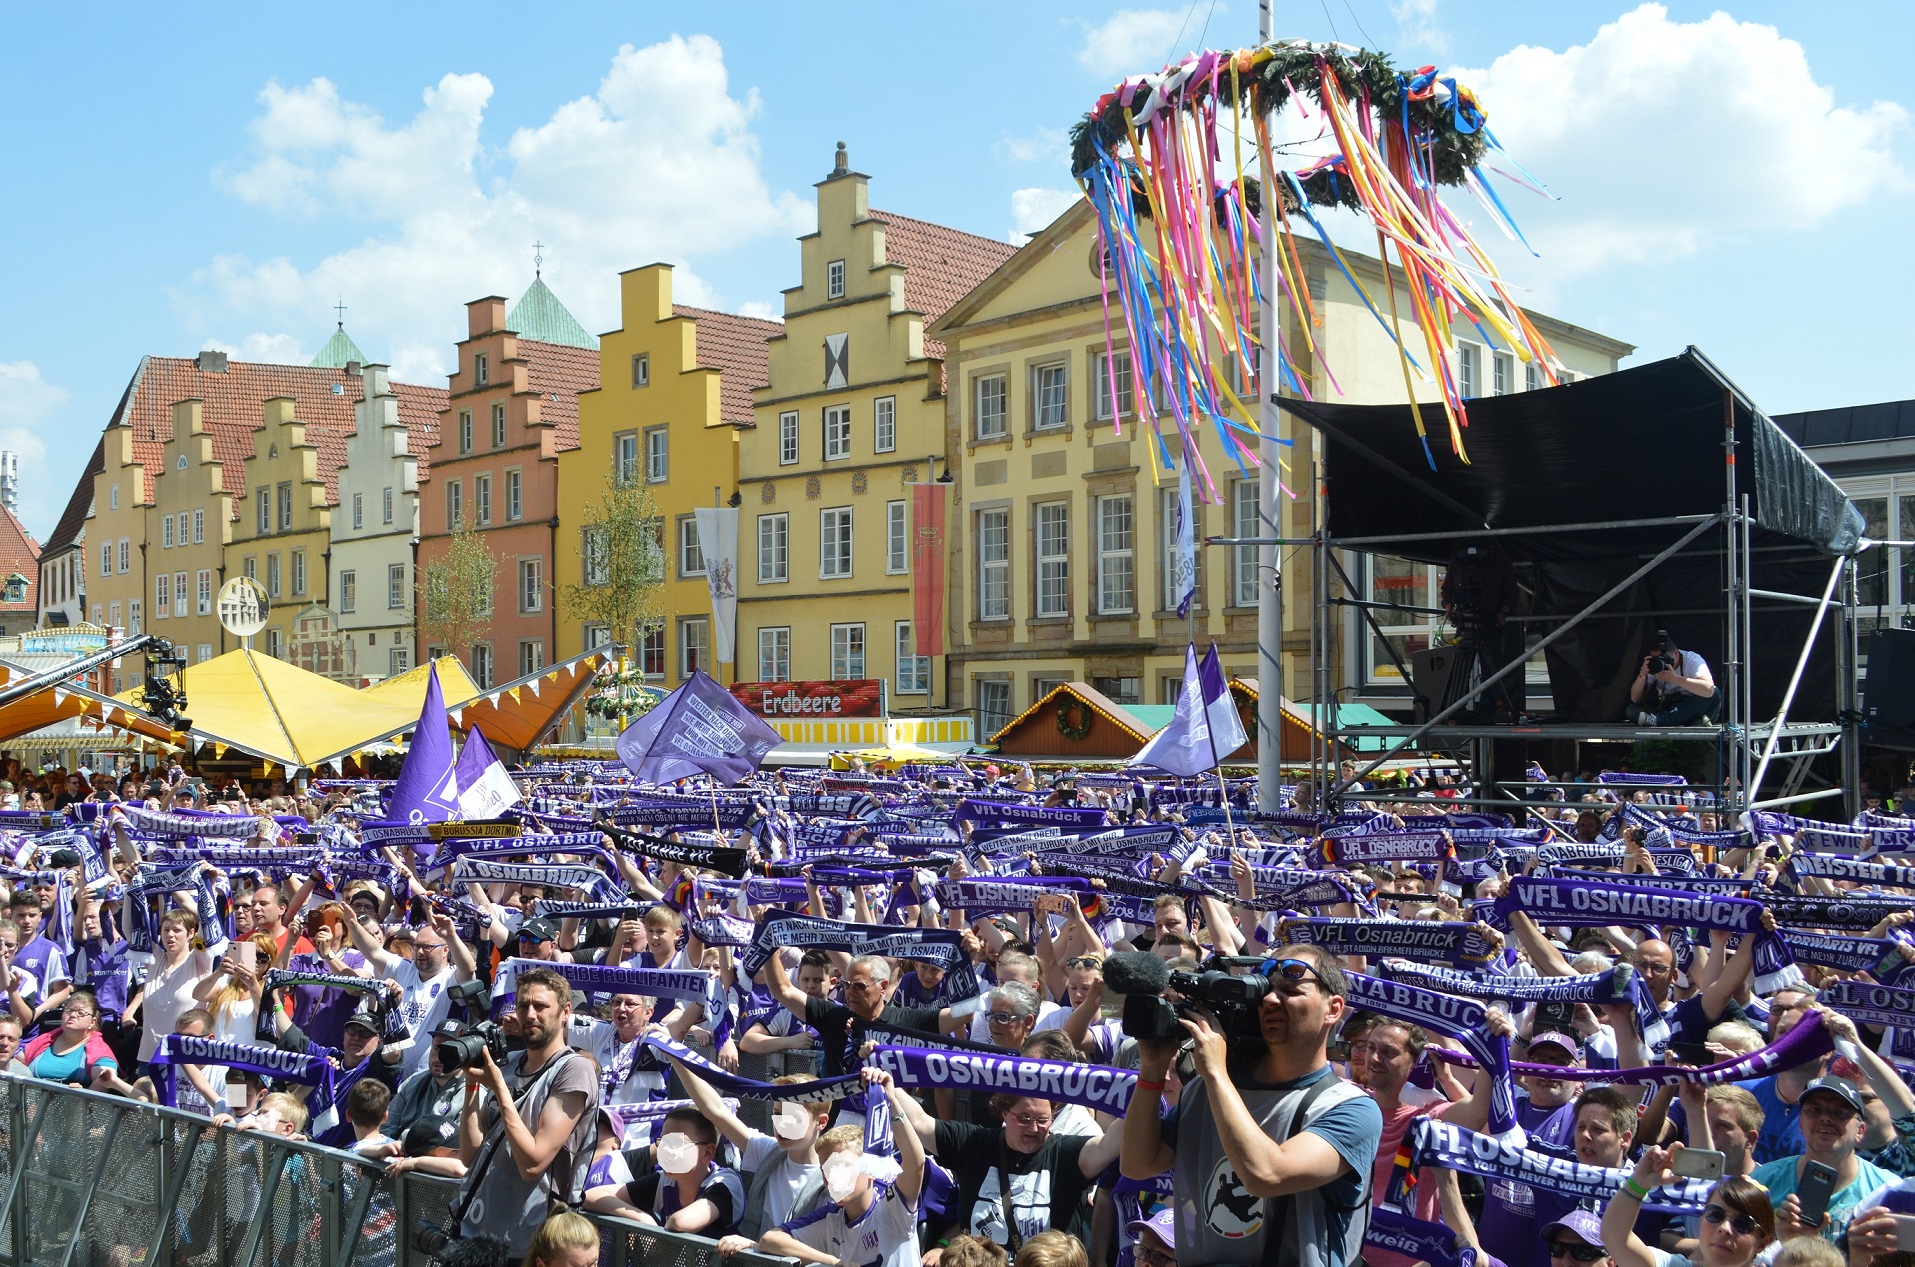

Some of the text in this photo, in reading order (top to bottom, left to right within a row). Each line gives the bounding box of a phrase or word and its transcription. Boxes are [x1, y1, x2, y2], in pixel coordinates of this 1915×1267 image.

[762, 690, 842, 714] Erdbeere
[690, 695, 711, 718] WEITER
[708, 713, 725, 732] NACH
[683, 713, 695, 727] NIE
[694, 721, 711, 739] MEHR
[686, 728, 708, 750] NUR MIT
[818, 796, 852, 811] 99
[654, 813, 676, 823] OBEN!
[678, 813, 689, 822] NIE
[690, 813, 710, 822] MEHR
[973, 802, 1082, 823] VfL Osnabrück
[0, 815, 64, 826] SNABRÜCK FC
[541, 819, 591, 832] Osnabrüc
[373, 826, 423, 840] OSNABRÜCK
[443, 824, 521, 837] BORUSSIA DORTMUN
[804, 826, 842, 839] 2019
[385, 837, 424, 846] ACHTELFINALE
[470, 840, 504, 851] VFL
[981, 827, 1060, 853] WEITER NACH OBEN!
[1070, 841, 1088, 854] NUR
[1087, 838, 1101, 849] MIT
[1100, 842, 1116, 853] VFL
[168, 850, 206, 860] VfL
[1044, 853, 1134, 867] NEVER WALK ALONE
[1650, 856, 1691, 870] DESLIGA
[1790, 855, 1886, 881] MEISTER
[478, 862, 602, 894] OSNABRÜCK
[938, 884, 969, 901] VFL
[984, 900, 1007, 908] NEVER
[1517, 883, 1753, 930] VFL OSNABRÜCK
[1799, 896, 1913, 906] YOU'LL NEVER WALK
[1108, 906, 1135, 919] 2018
[785, 920, 811, 932] NACH
[1329, 917, 1444, 928] YOU'LL NEVER WALK ALONE
[1805, 922, 1847, 930] EINMAL
[773, 933, 789, 947] NIE
[790, 932, 818, 944] MEHR
[856, 933, 918, 955] NUR MIT DIR,
[1312, 924, 1458, 949] VFL Osnabrück
[1462, 931, 1482, 955] 100
[891, 946, 909, 957] VFL
[1327, 944, 1342, 955] VFL
[1412, 947, 1447, 959] BRÜCKE
[1783, 932, 1880, 958] VORWÄRTS VFL
[1794, 947, 1810, 959] NIE
[1810, 951, 1834, 964] MEHR
[93, 968, 129, 977] sunmaker
[602, 966, 707, 996] ROLLIFANTEN
[1391, 975, 1427, 988] WEITER
[1427, 977, 1457, 993] NACH
[1456, 981, 1491, 997] OBEN!
[1512, 987, 1545, 1000] MEHR
[1548, 985, 1595, 1001] ZURÜCK!
[1826, 983, 1861, 1006] FL
[1365, 998, 1388, 1010] 1899
[747, 1006, 773, 1018] sunm
[1887, 1012, 1915, 1027] NEV
[891, 1034, 926, 1050] SIND
[925, 1052, 1140, 1111] OSNABRÜCK
[1430, 1123, 1467, 1152] FL
[1518, 1170, 1556, 1188] NEVER
[1558, 1180, 1592, 1196] WALK
[1367, 1229, 1419, 1253] weiß
